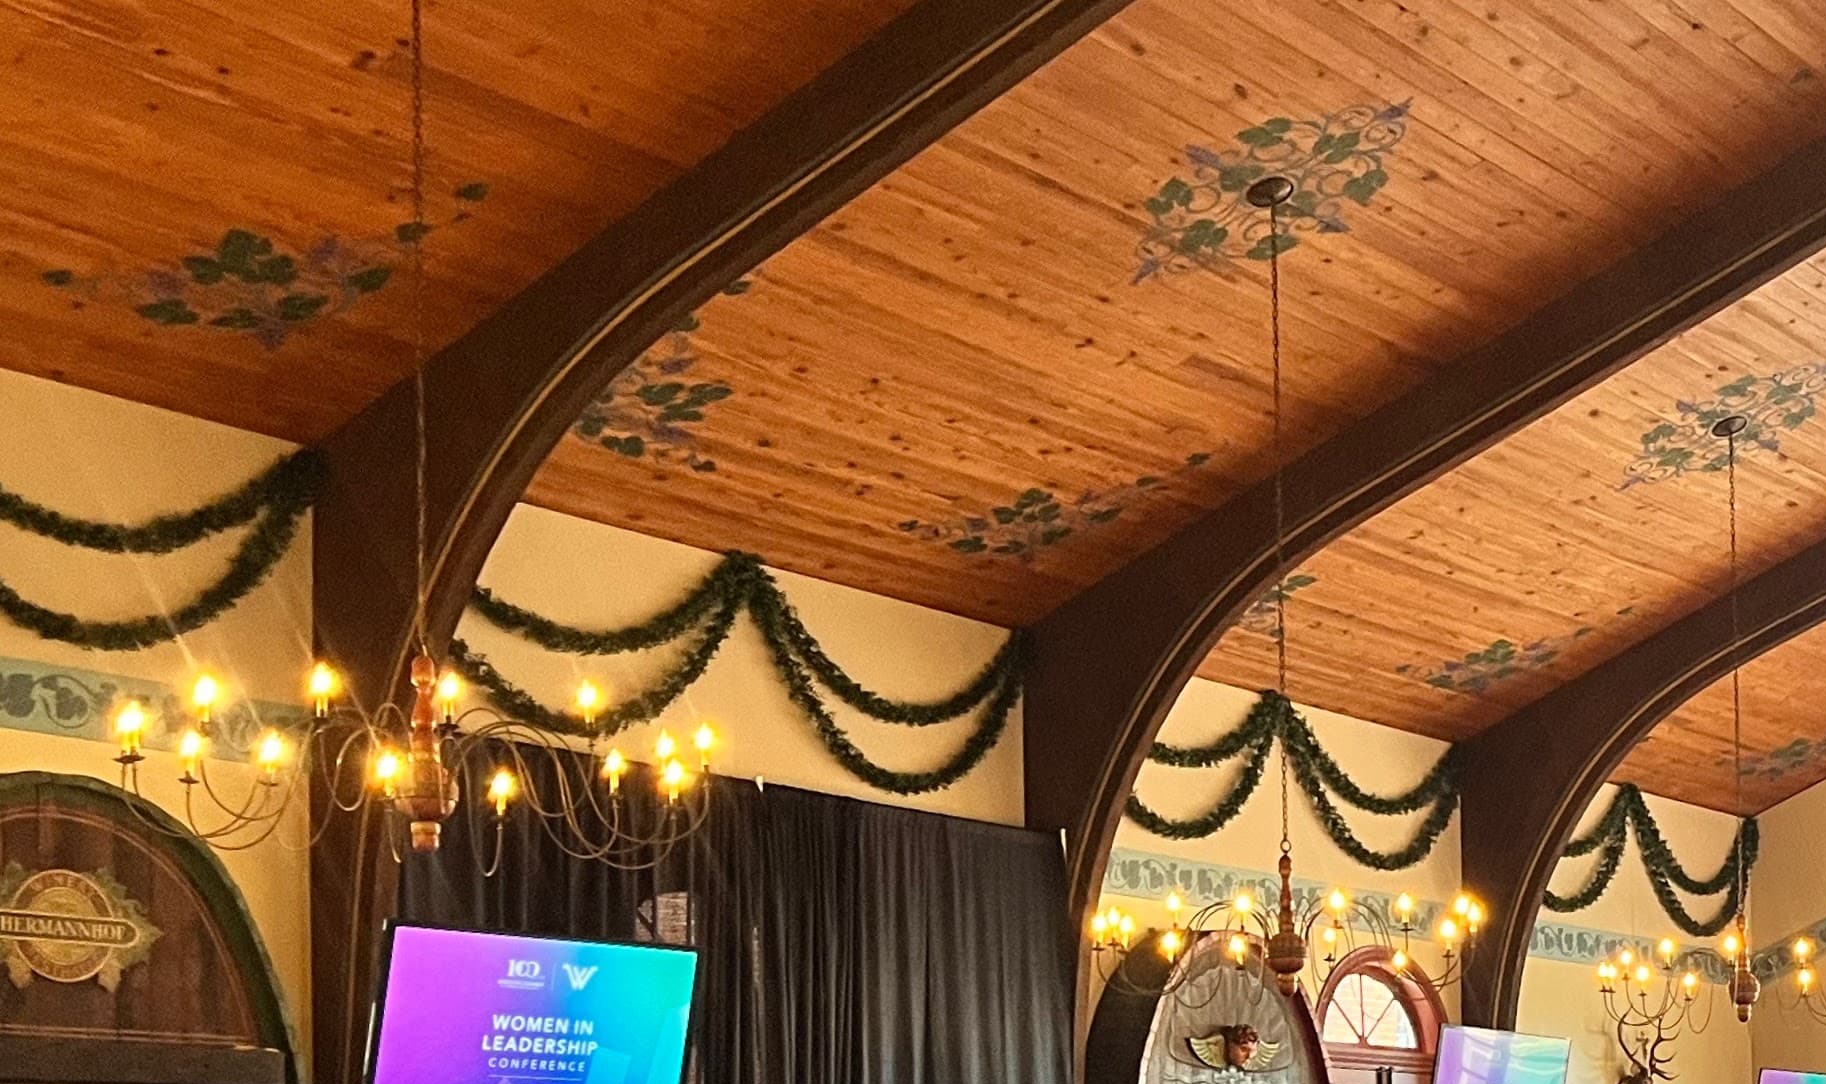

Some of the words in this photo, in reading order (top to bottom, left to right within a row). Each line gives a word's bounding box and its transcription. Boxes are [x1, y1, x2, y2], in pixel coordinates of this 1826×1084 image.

[0, 914, 126, 941] HERMANNHOF
[492, 1014, 570, 1034] WOMEN
[574, 1020, 595, 1036] IN
[481, 1034, 599, 1057] LEADERSHIP
[488, 1057, 586, 1072] CONFERENCE
